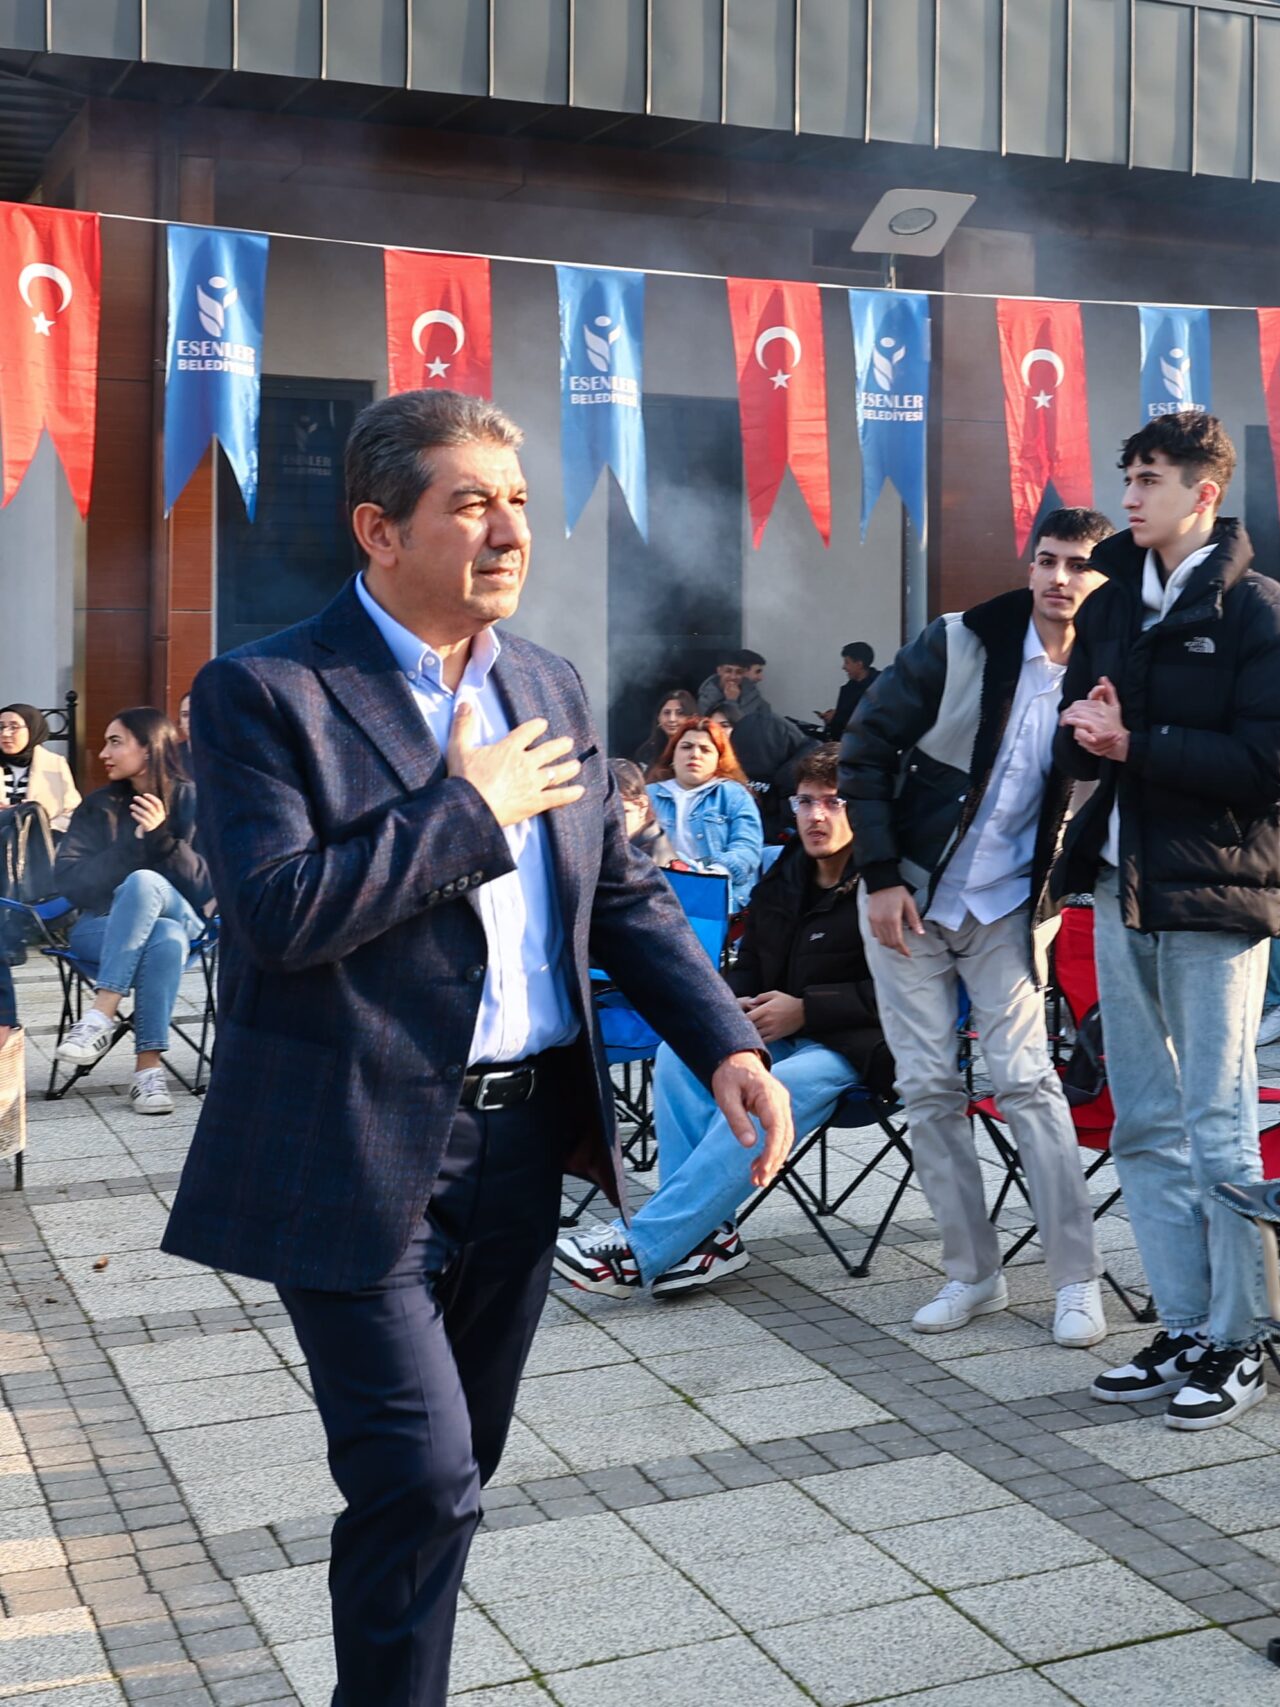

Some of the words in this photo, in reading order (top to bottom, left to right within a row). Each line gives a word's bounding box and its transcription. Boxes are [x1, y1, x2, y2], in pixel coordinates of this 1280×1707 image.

[177, 340, 256, 363] ESENLER
[570, 376, 638, 394] ESENLER
[861, 392, 924, 409] ESENLER
